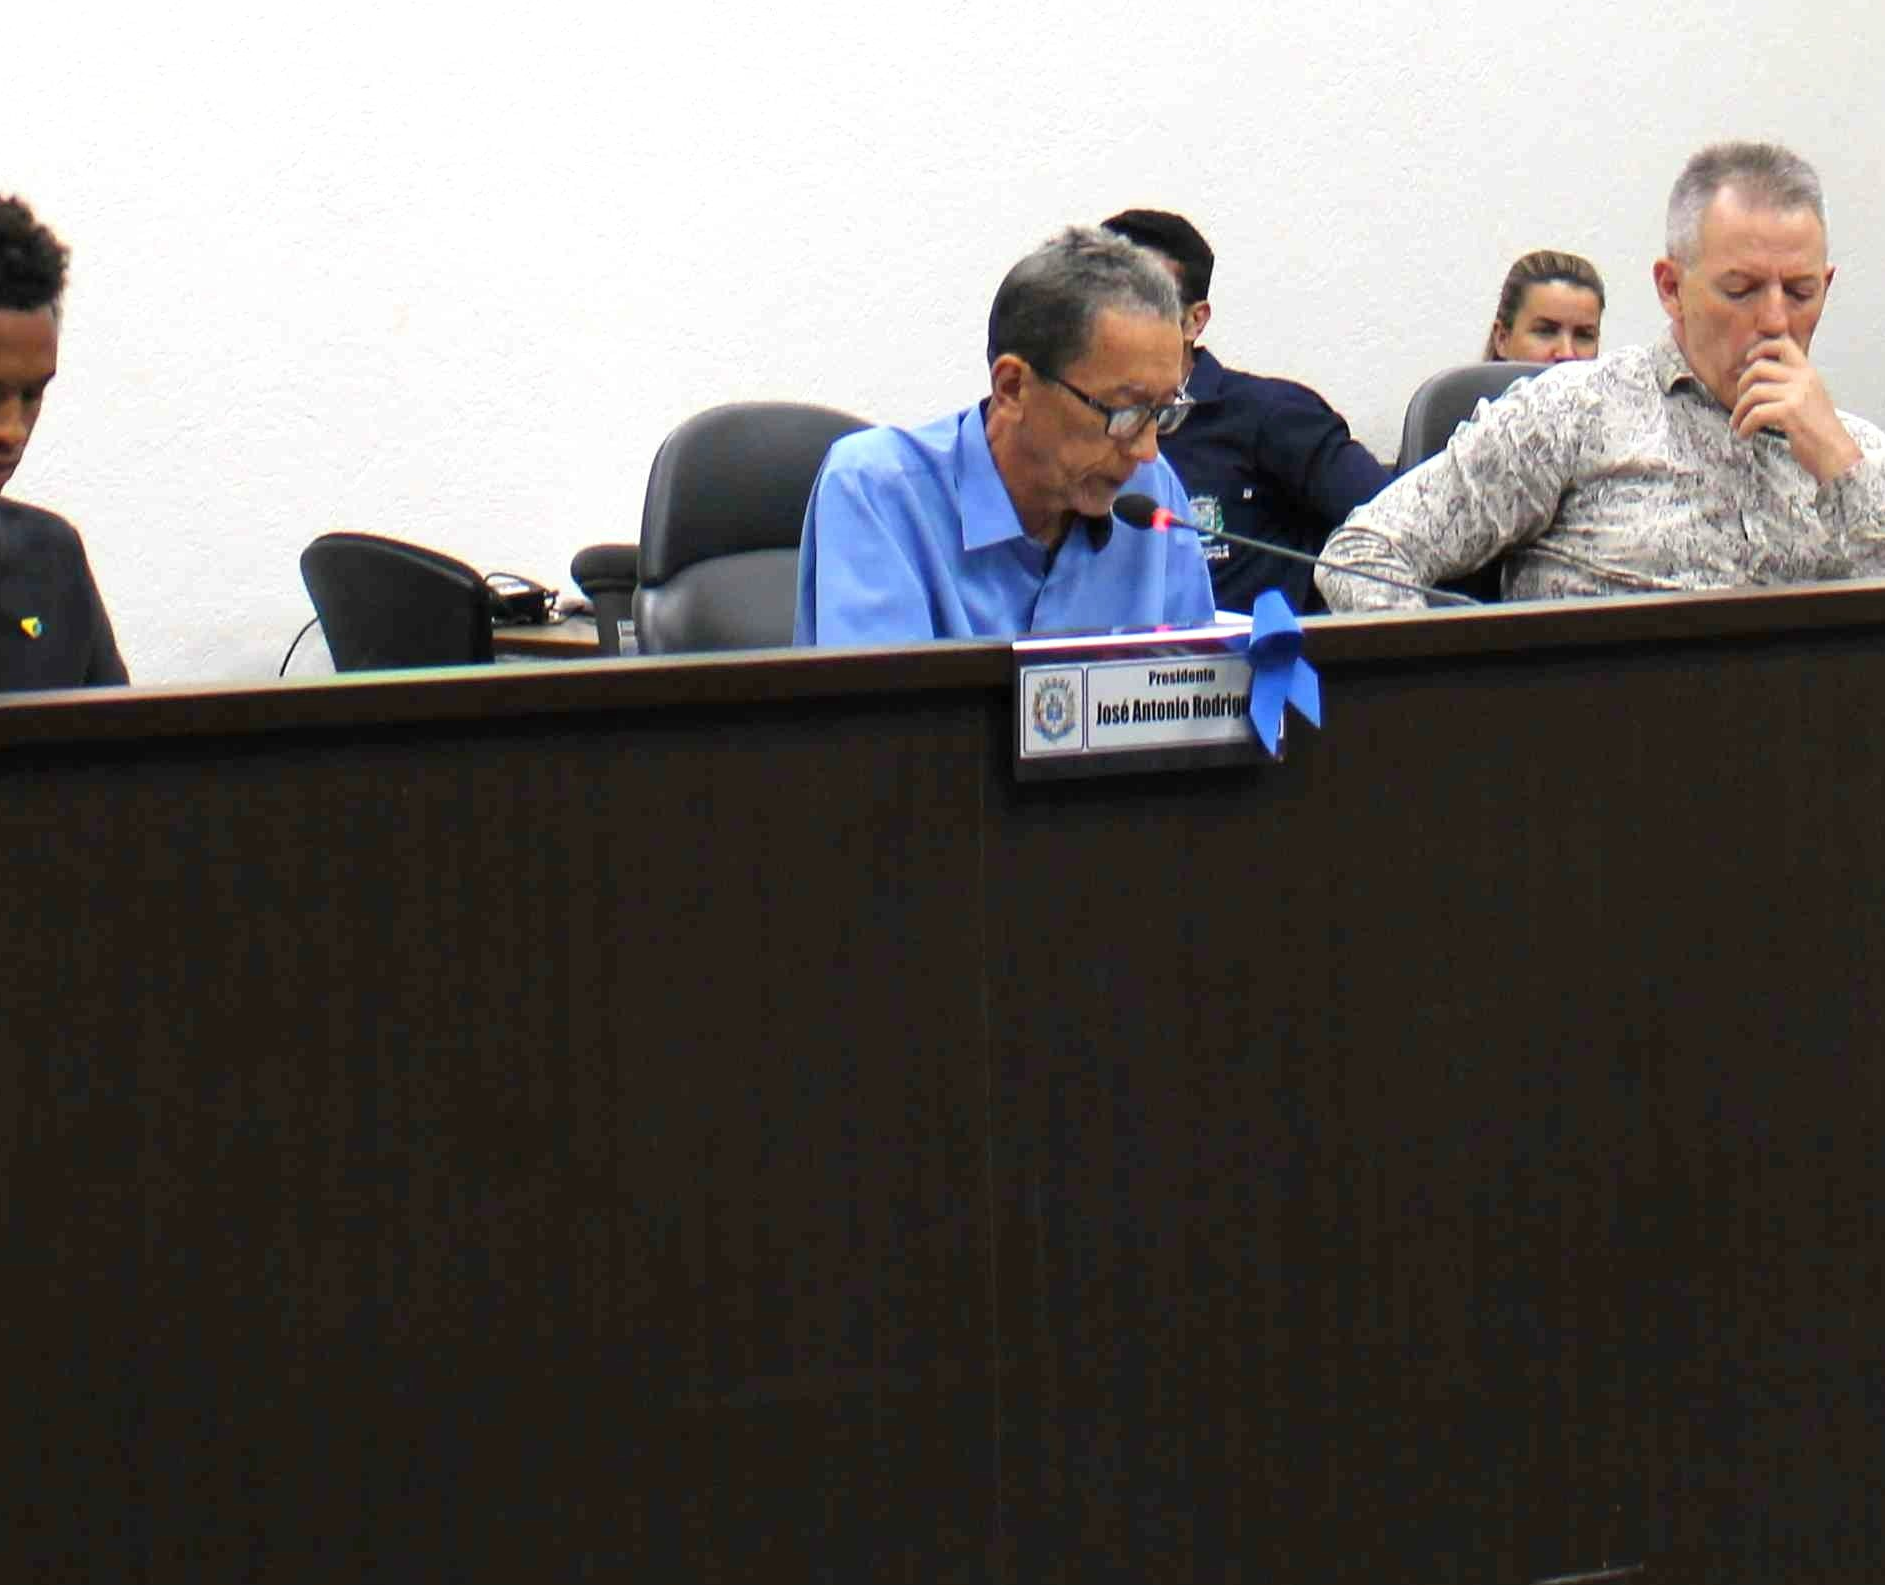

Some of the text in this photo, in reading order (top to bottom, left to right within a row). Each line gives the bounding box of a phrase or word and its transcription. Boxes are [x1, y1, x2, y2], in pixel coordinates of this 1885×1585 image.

[1148, 667, 1216, 687] Presidente
[1096, 698, 1130, 726] José
[1132, 695, 1189, 723] Antonio
